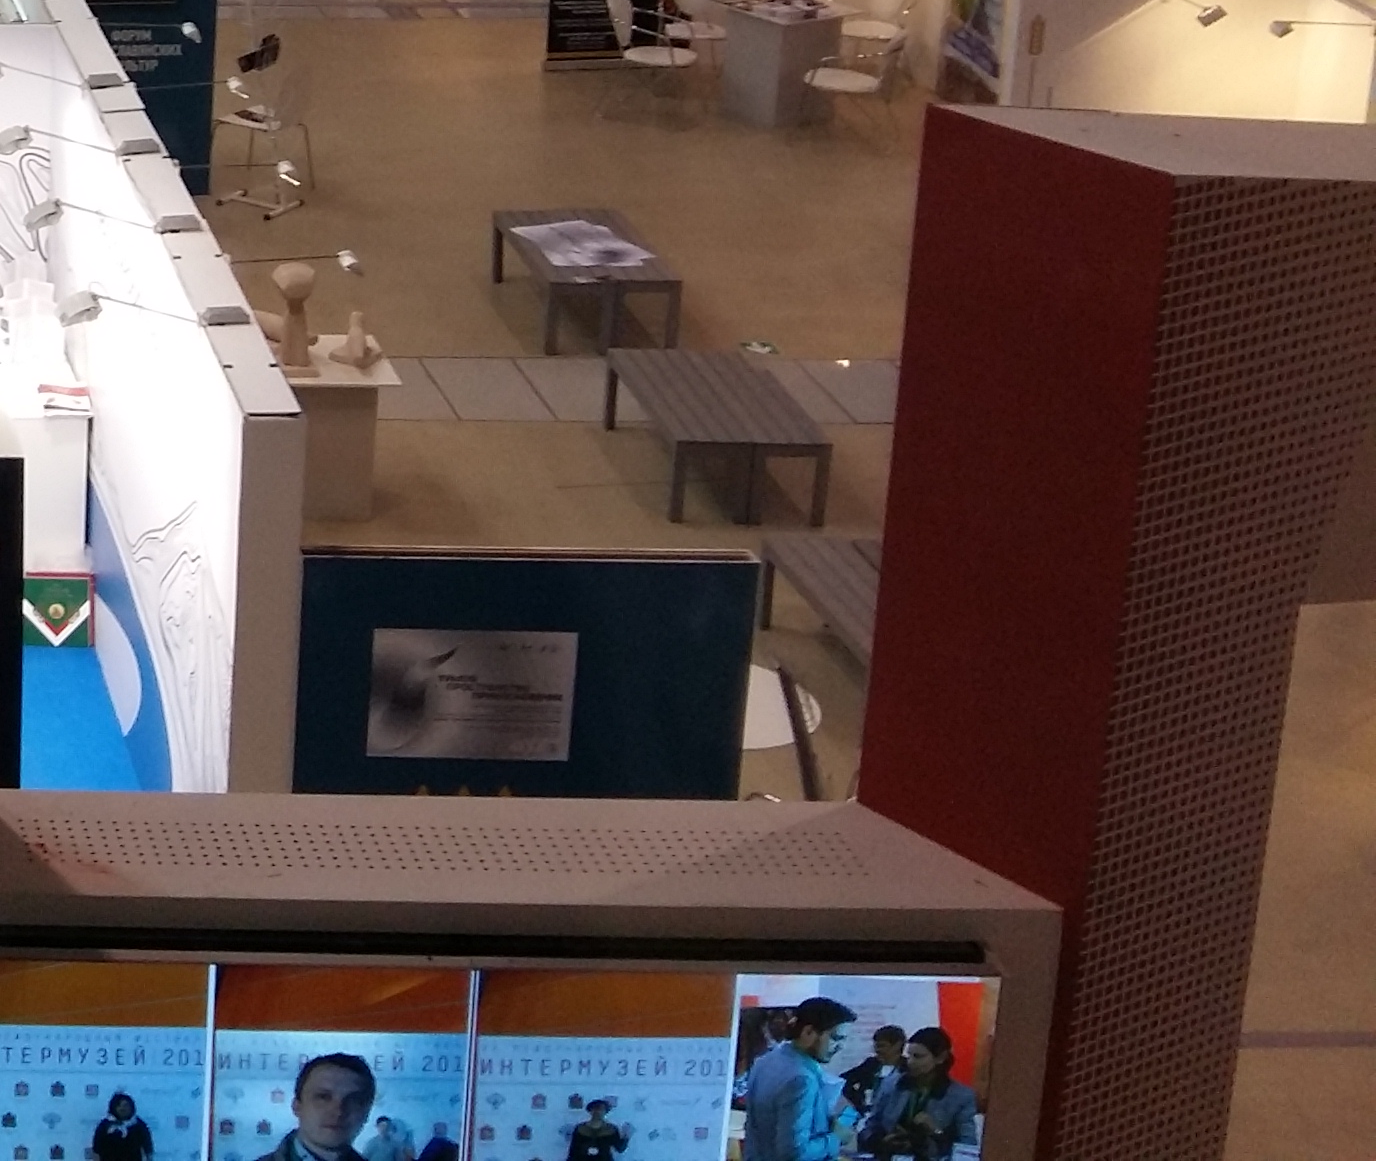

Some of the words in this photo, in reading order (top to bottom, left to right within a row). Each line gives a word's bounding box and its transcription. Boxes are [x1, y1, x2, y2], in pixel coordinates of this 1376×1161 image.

[162, 1047, 205, 1067] 201
[421, 1055, 464, 1073] 201
[480, 1054, 668, 1078] ИНТЕРМУЗЕЙ
[684, 1058, 729, 1078] 201
